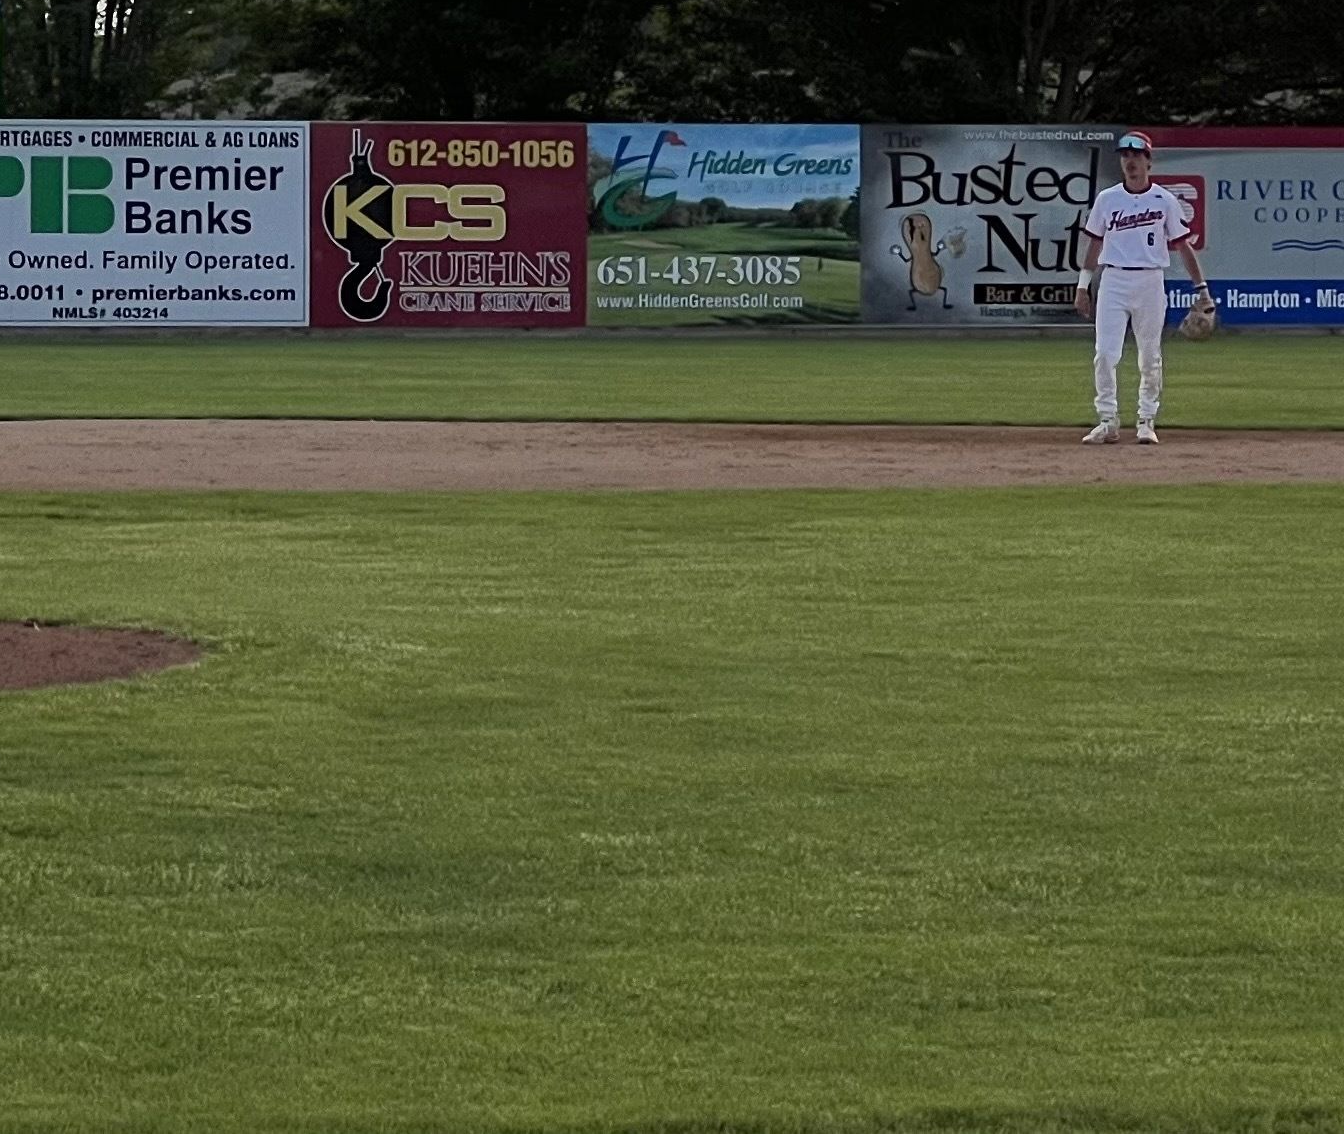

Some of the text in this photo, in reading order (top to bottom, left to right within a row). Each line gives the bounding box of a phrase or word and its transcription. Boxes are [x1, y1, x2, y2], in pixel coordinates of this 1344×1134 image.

[91, 132, 199, 148] COMMERCIAL
[205, 132, 217, 148] &
[222, 132, 244, 148] AG
[249, 132, 299, 148] LOANS
[883, 131, 922, 148] The
[964, 129, 1114, 141] www.thebustednut.com
[387, 139, 575, 167] 612-850-1056
[125, 157, 284, 191] Premier
[687, 150, 853, 182] Hidden Greens
[884, 144, 1100, 209] Busted
[1217, 179, 1317, 201] RIVER
[125, 201, 252, 235] Banks
[333, 184, 506, 241] KCS
[977, 210, 1087, 275] Nut
[1147, 232, 1155, 246] 6
[8, 250, 94, 269] Owned.
[102, 250, 178, 274] Family
[184, 251, 296, 274] Operated.
[596, 256, 801, 285] 651-437-3085
[92, 285, 296, 303] premierbanks.com
[399, 293, 571, 312] CRANE SERVICE
[596, 293, 803, 309] www.HiddenGreensGolf.com
[985, 286, 1015, 302] Bar
[1020, 286, 1036, 302] &
[1227, 289, 1300, 312] Hampton
[52, 307, 169, 319] NMLS# 403214
